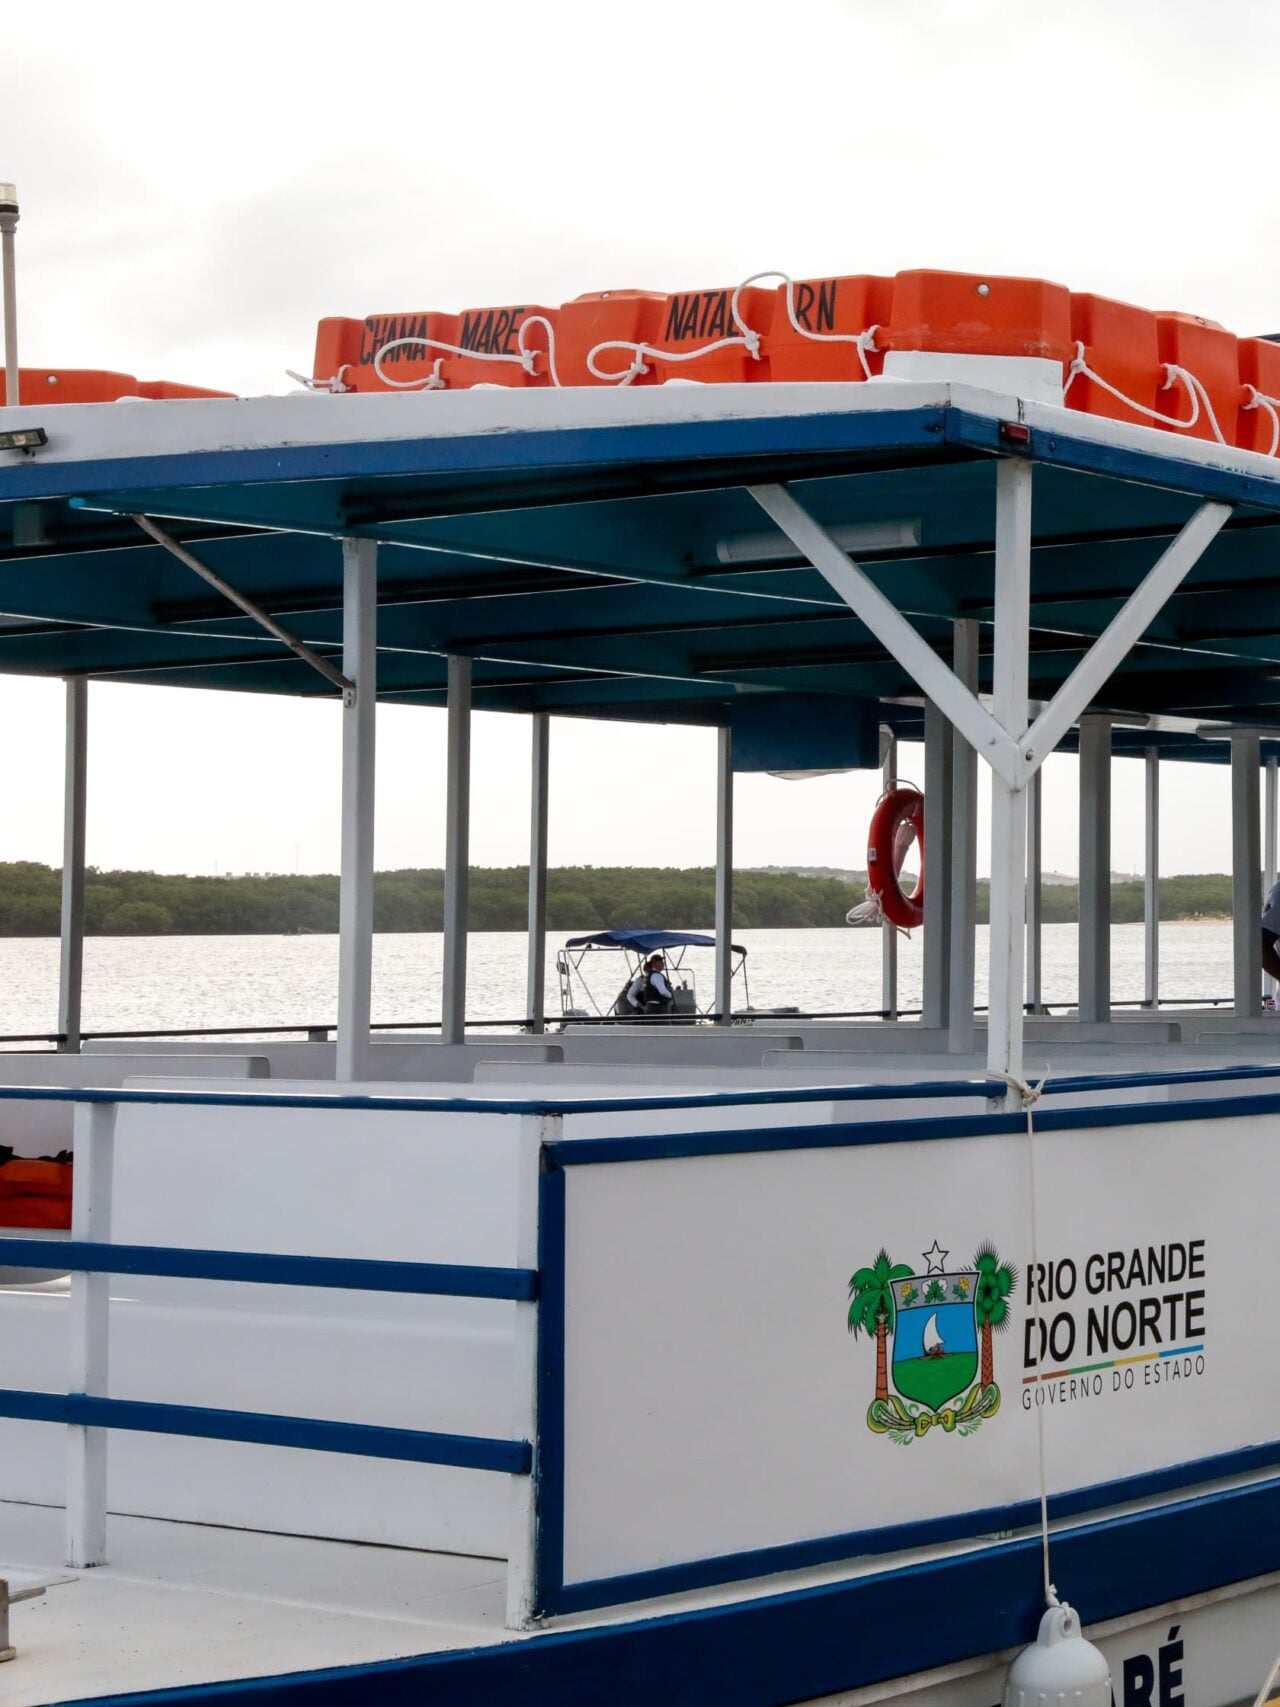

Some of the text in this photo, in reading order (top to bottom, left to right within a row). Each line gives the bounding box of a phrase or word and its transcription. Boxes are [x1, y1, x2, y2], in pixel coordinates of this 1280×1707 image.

[665, 291, 740, 342] NATAL
[794, 279, 837, 332] RN
[1026, 1239, 1206, 1306] RIO GRANDE
[1024, 1290, 1206, 1369] DO NORTE
[1022, 1355, 1205, 1411] GOVERNO DO ESTADO
[1111, 1625, 1185, 1707] RÉ
